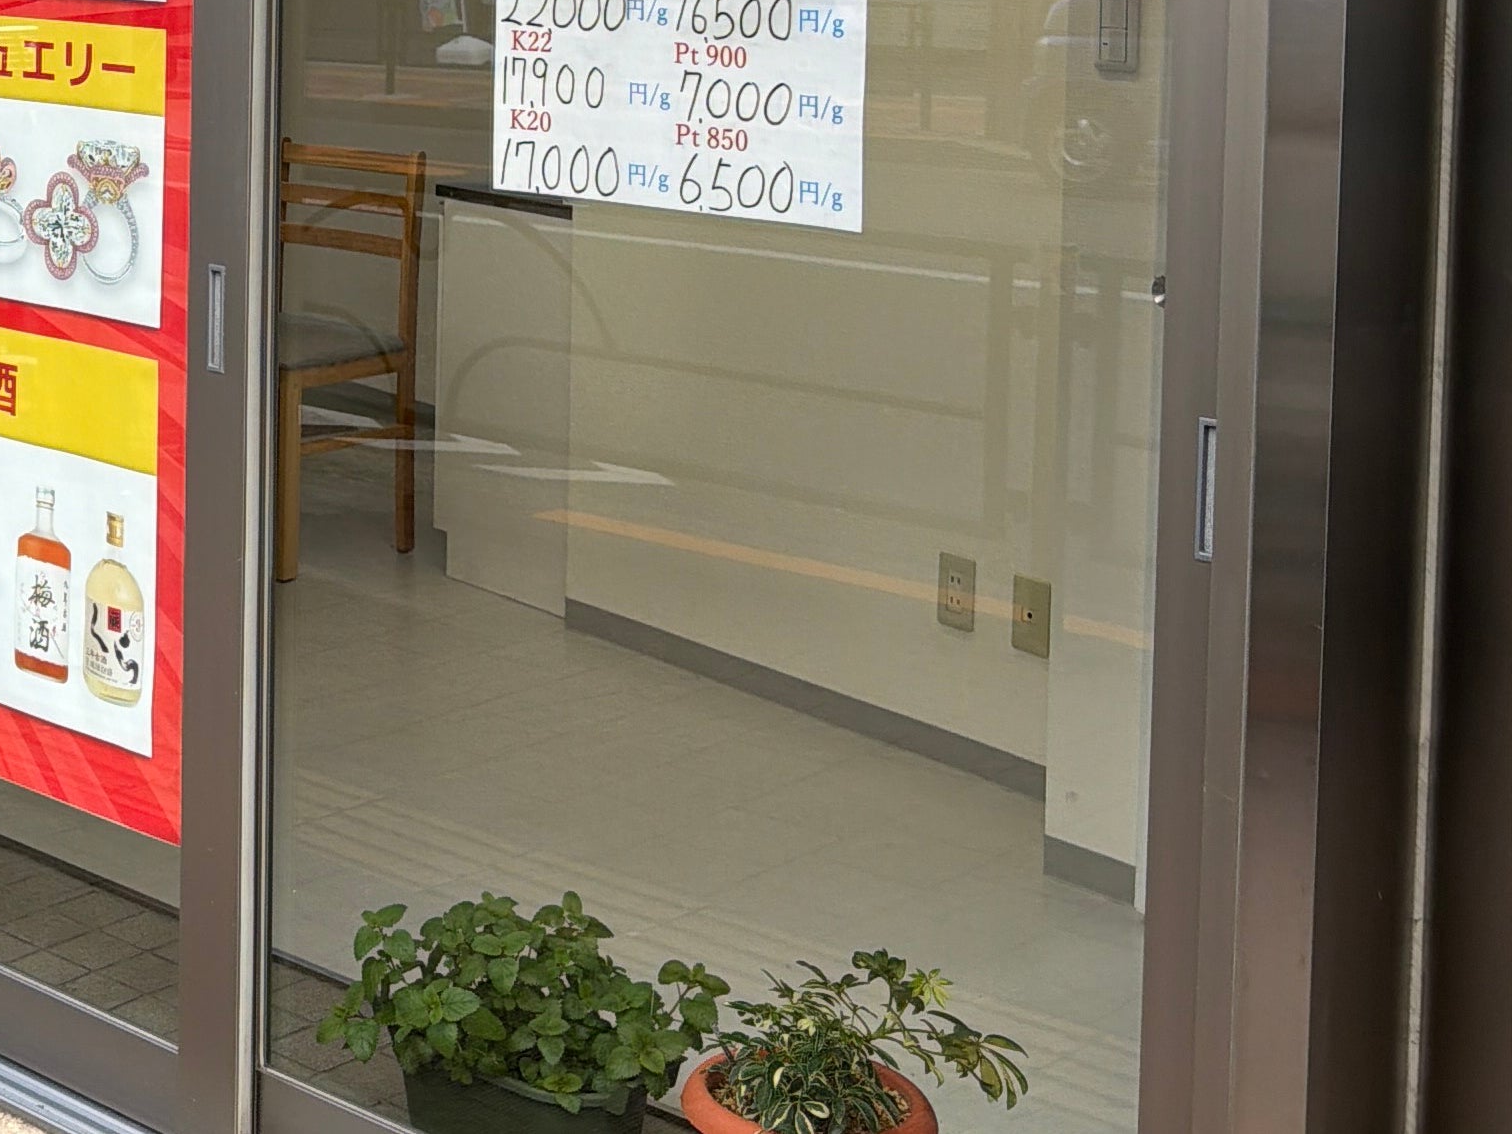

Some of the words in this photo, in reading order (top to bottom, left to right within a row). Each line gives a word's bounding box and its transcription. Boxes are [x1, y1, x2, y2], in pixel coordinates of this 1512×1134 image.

[799, 9, 845, 38] 円/g
[511, 30, 553, 52] K22
[674, 42, 699, 65] Pt
[706, 44, 747, 68] 900
[629, 82, 671, 110] 円/g
[799, 94, 844, 124] 円/g
[510, 109, 552, 132] K20
[675, 123, 700, 147] Pt
[707, 127, 748, 151] 850
[628, 163, 670, 192] 円/g
[799, 180, 843, 212] 円/g
[27, 572, 56, 654] 梅酒
